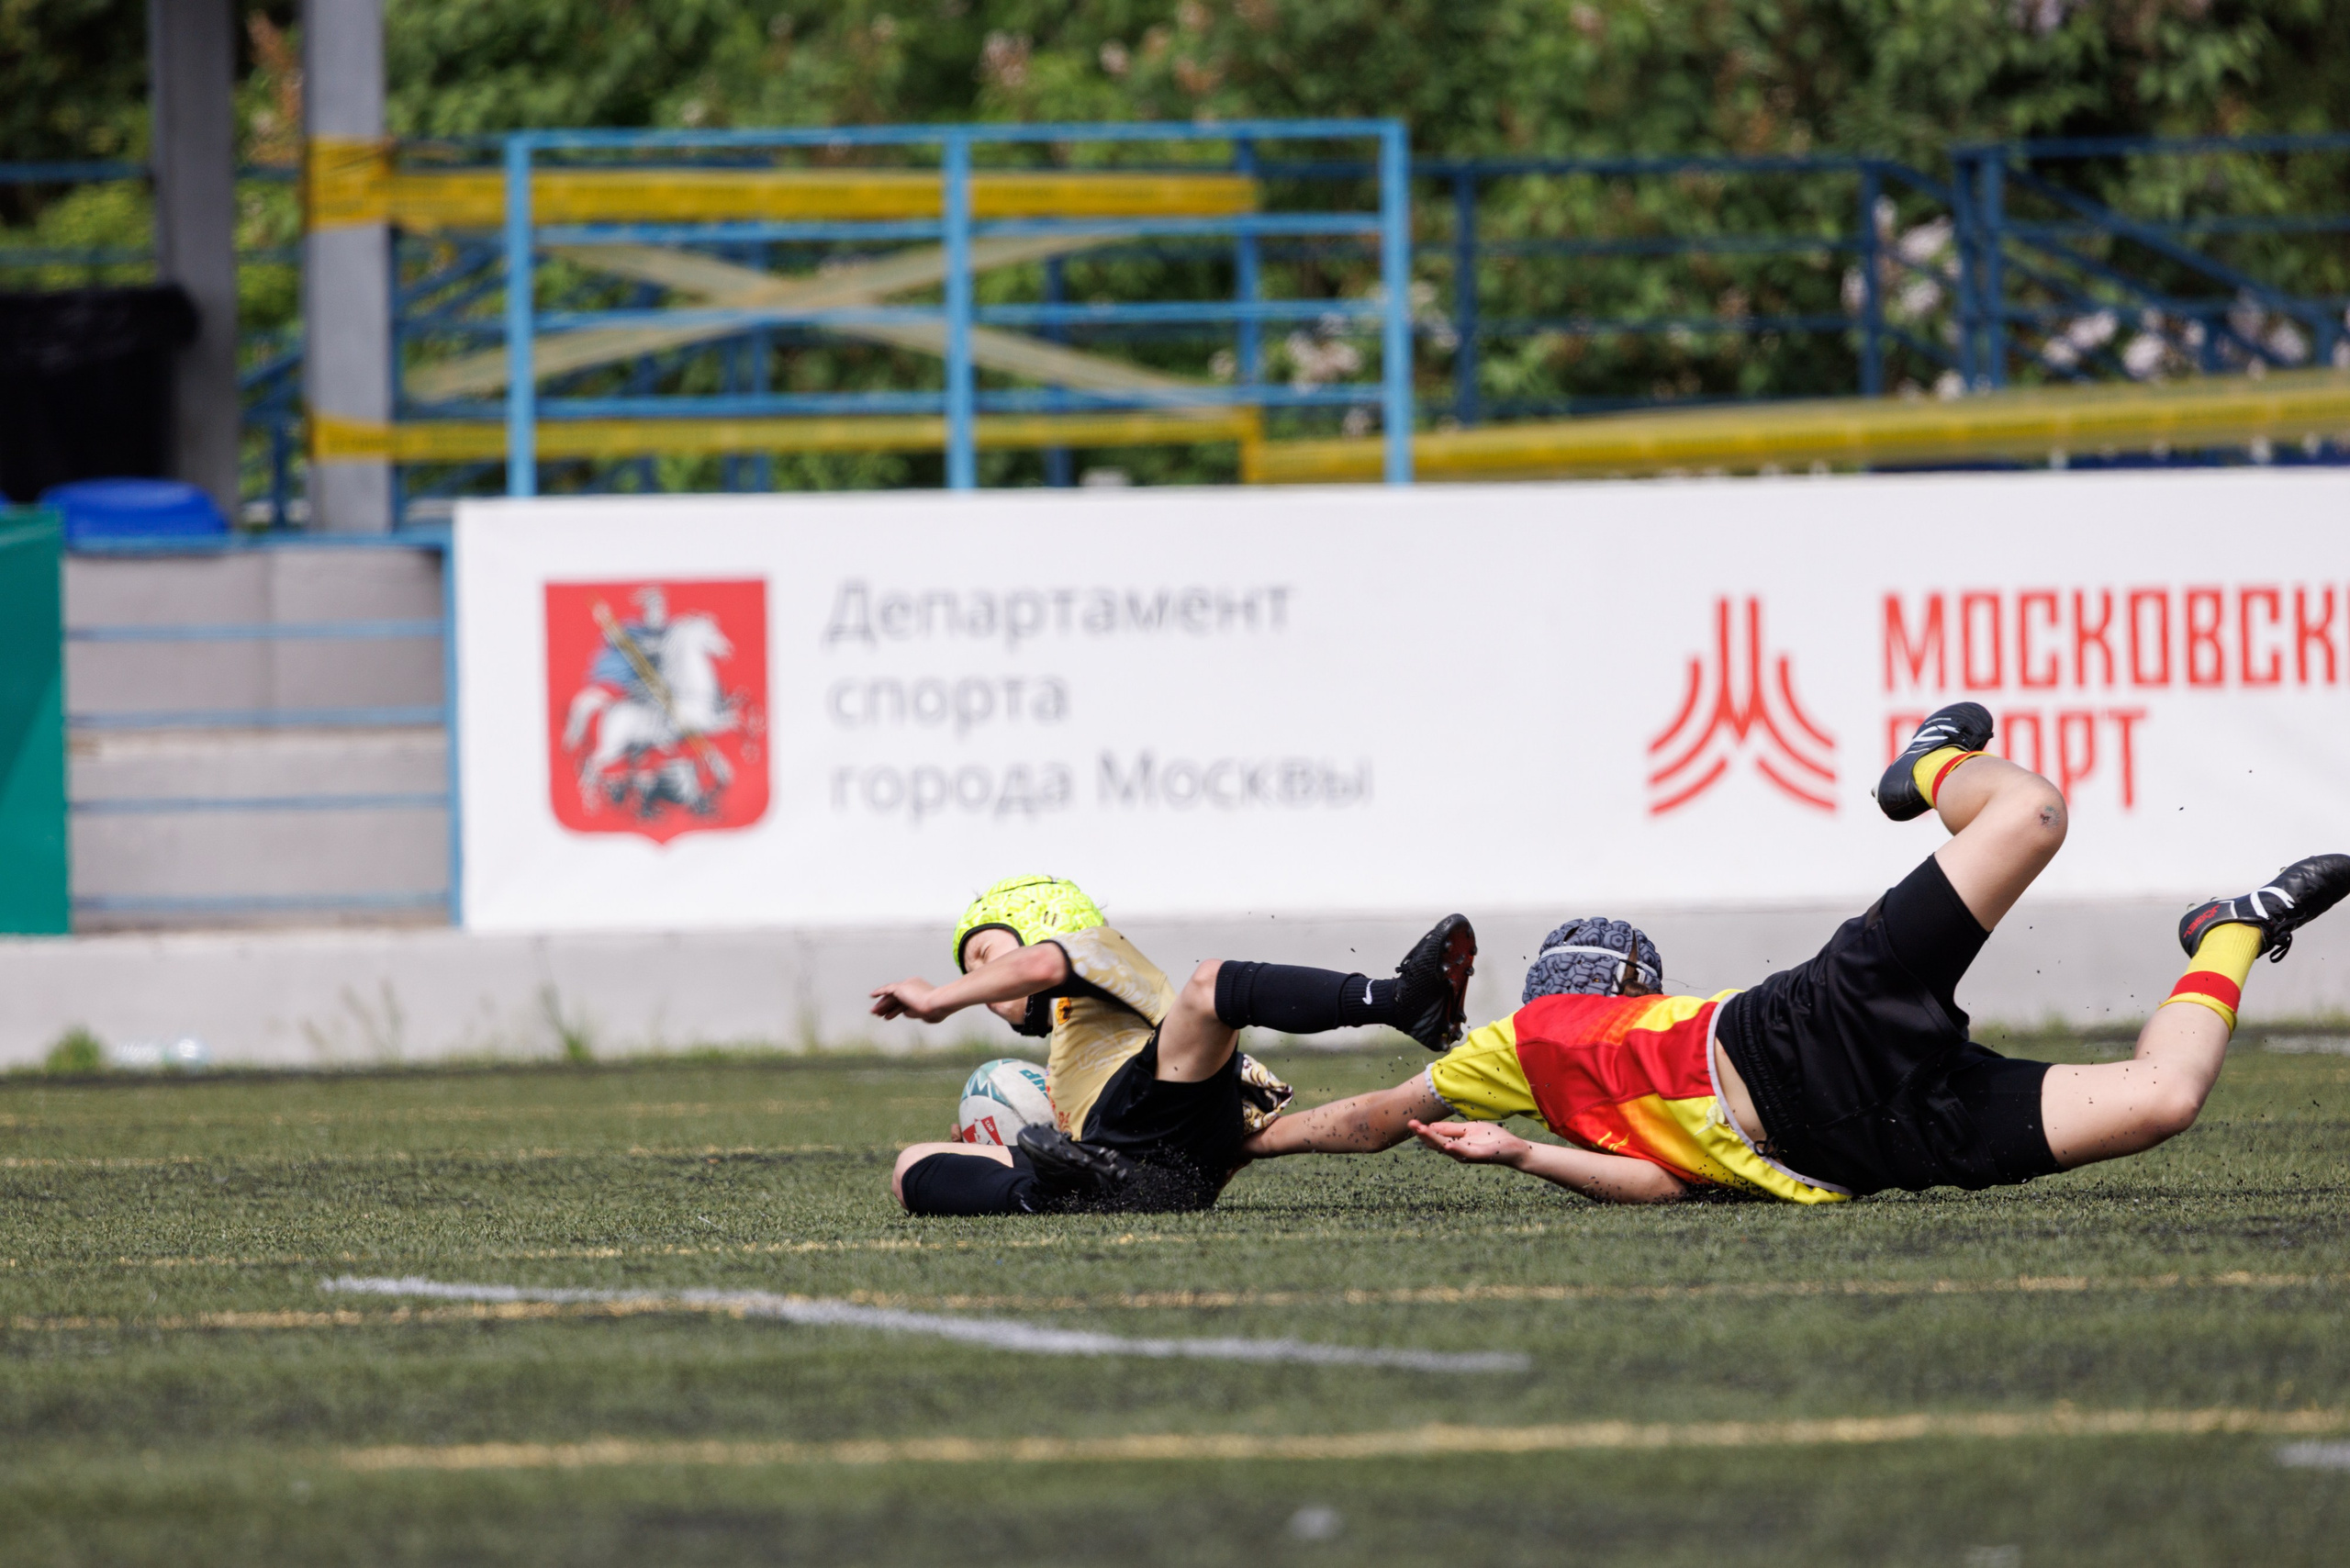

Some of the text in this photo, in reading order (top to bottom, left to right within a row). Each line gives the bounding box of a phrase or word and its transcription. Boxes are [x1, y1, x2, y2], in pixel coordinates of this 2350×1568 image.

[822, 578, 1294, 653] Департамент
[1883, 586, 2350, 691] МОСКОВСК
[827, 675, 1071, 740] спорта
[831, 748, 1373, 826] города Москвы
